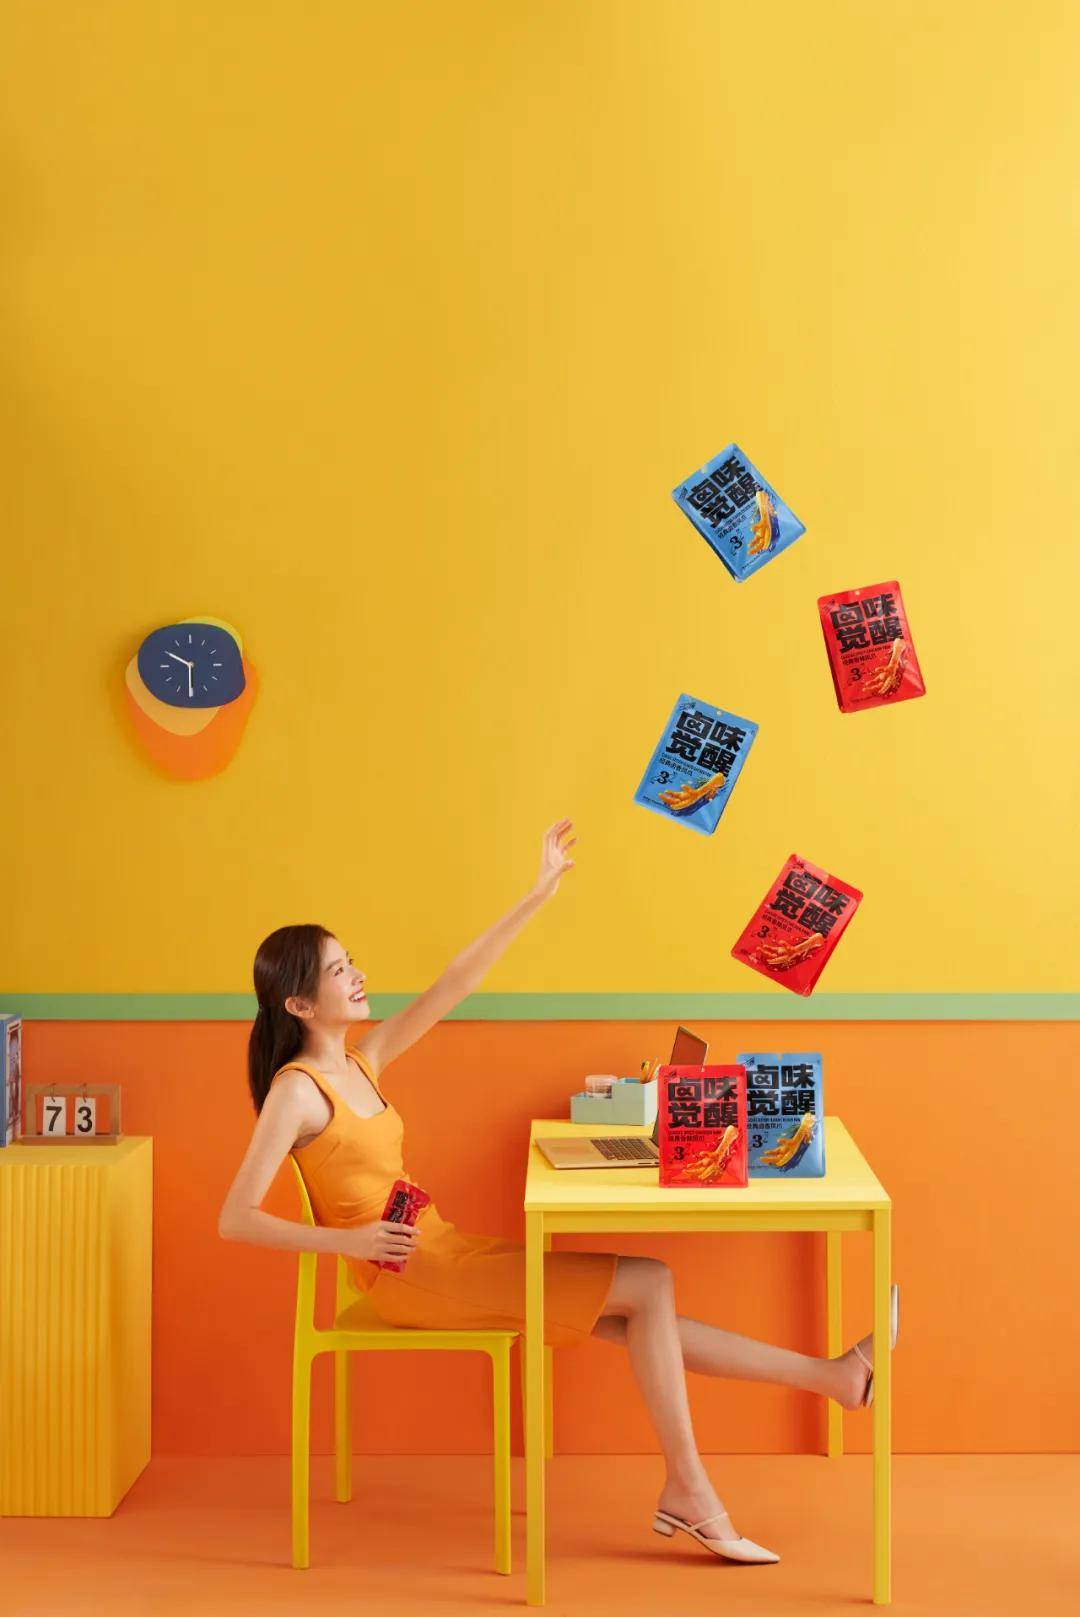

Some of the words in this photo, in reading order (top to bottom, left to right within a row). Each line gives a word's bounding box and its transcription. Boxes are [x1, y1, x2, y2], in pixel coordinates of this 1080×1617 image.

[686, 456, 746, 511] 卤味
[700, 472, 764, 528] 觉醒
[830, 593, 898, 628] 卤味
[835, 616, 905, 654] 觉醒
[850, 667, 862, 682] 3
[676, 710, 747, 753] 卤味
[666, 730, 737, 778] 觉醒
[657, 770, 670, 785] 3
[782, 870, 850, 916] 卤味
[769, 888, 838, 939] 觉醒
[757, 925, 770, 939] 3
[668, 1076, 738, 1102] 卤味
[746, 1063, 816, 1089] 卤味
[668, 1102, 739, 1129] 觉醒
[746, 1089, 816, 1116] 觉醒
[45, 1105, 63, 1132] 7
[77, 1106, 93, 1133] 3
[673, 1146, 685, 1161] 3
[752, 1134, 763, 1148] 3
